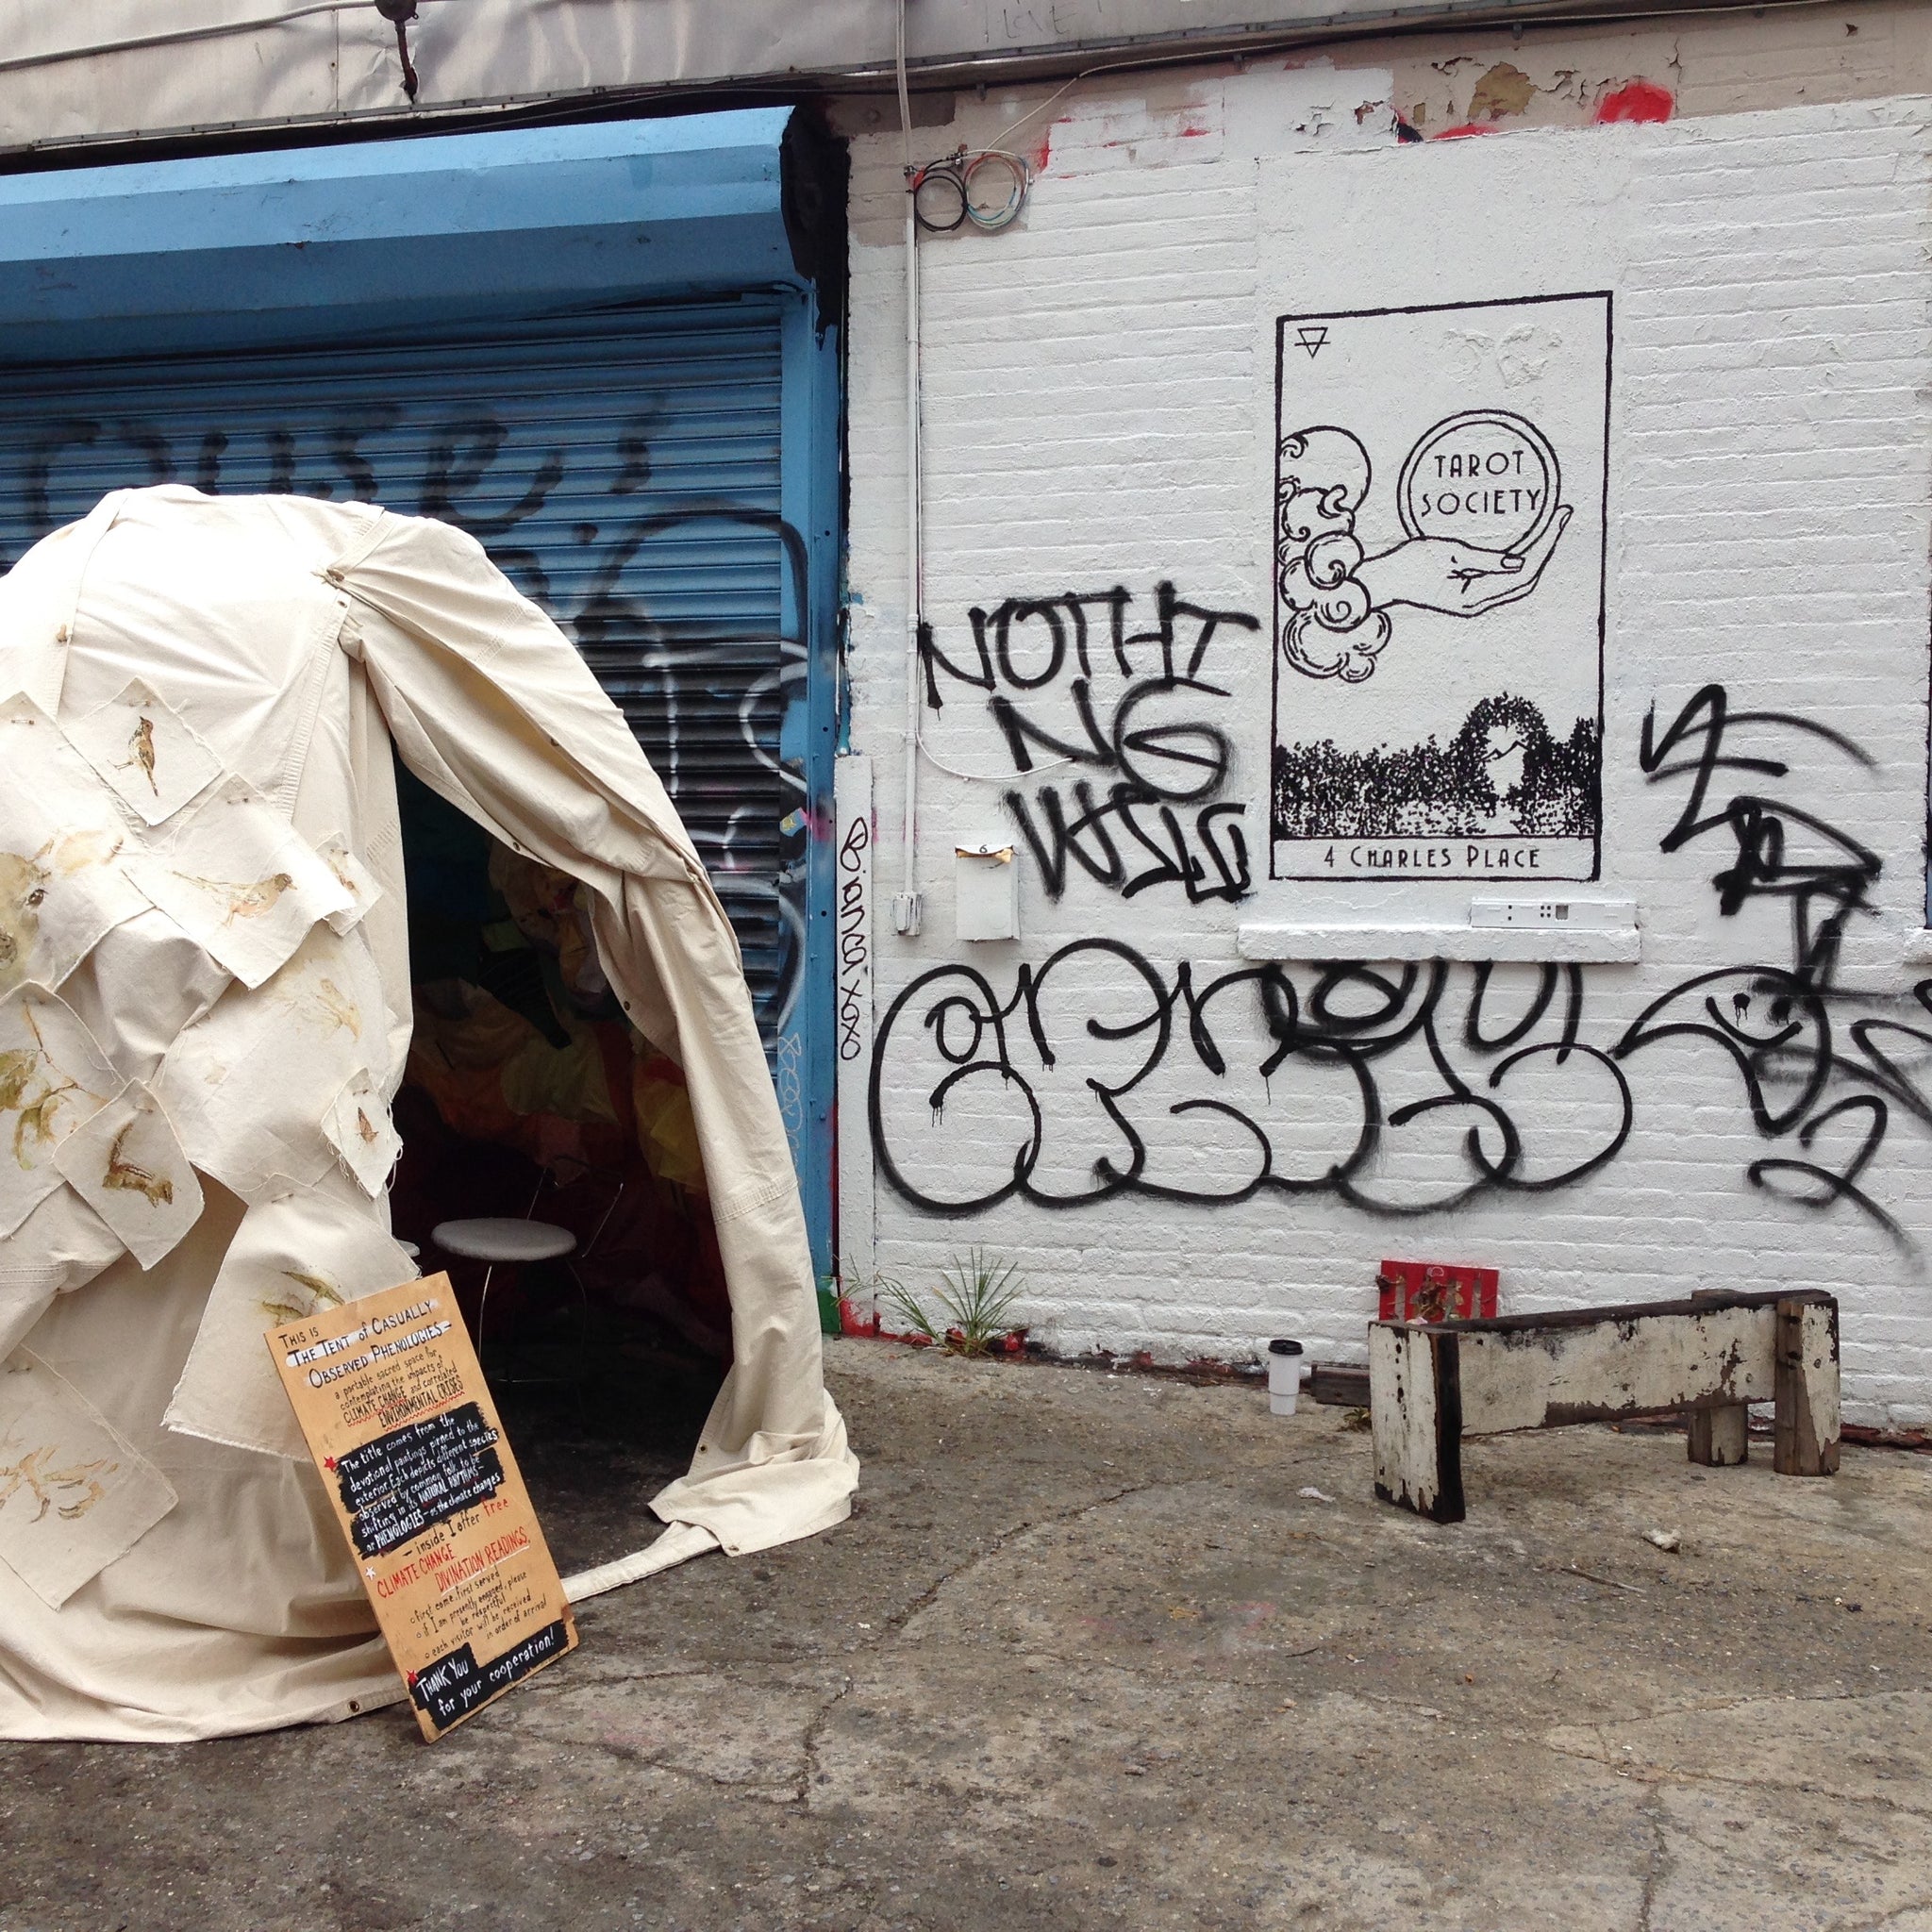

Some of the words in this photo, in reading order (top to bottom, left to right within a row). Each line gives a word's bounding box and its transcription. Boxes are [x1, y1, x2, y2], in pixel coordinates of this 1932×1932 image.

[1434, 450, 1524, 478] TAROT
[1421, 489, 1541, 517] SOCIETY
[978, 843, 988, 854] 6
[1324, 845, 1335, 868] 4
[1350, 845, 1452, 868] CHARLES
[1467, 844, 1541, 868] PLACE
[278, 1331, 307, 1349] THIS
[308, 1326, 319, 1339] IS
[287, 1348, 317, 1367] THE
[315, 1335, 350, 1357] TENT
[358, 1322, 369, 1341] of
[372, 1300, 433, 1335] CASUALLY
[308, 1356, 369, 1389] OBSERVED
[335, 1391, 340, 1400] a
[342, 1374, 374, 1400] portable
[376, 1358, 401, 1380] sacred
[404, 1352, 425, 1374] space
[425, 1346, 437, 1359] for
[340, 1381, 391, 1410] contemplating
[391, 1375, 405, 1388] the
[408, 1361, 435, 1385] impacts
[436, 1355, 445, 1369] of
[342, 1398, 378, 1424] CLIMATE
[377, 1386, 408, 1408] CHANGE
[410, 1381, 422, 1394] and
[423, 1360, 458, 1388] correlated
[377, 1389, 439, 1428] ENVIRONMENTAL
[436, 1374, 464, 1400] CRISES
[341, 1458, 360, 1474] The
[359, 1443, 383, 1465] title
[386, 1432, 413, 1451] comes
[414, 1423, 436, 1439] from
[440, 1412, 455, 1427] the
[350, 1456, 393, 1492] devotional
[394, 1445, 427, 1474] paintings
[429, 1427, 455, 1455] pinned
[457, 1426, 466, 1437] to
[466, 1419, 480, 1433] the
[409, 1458, 437, 1480] depicts
[437, 1439, 468, 1463] different
[469, 1429, 498, 1452] species
[358, 1493, 397, 1522] observed
[398, 1488, 412, 1505] by
[410, 1473, 441, 1493] common
[442, 1460, 458, 1476] folk
[459, 1457, 470, 1469] to
[469, 1454, 480, 1465] be
[361, 1512, 398, 1538] shifting
[396, 1504, 406, 1515] in
[408, 1497, 418, 1510] its
[418, 1478, 449, 1504] NATURAL
[437, 1498, 449, 1512] the
[448, 1489, 473, 1507] climate
[473, 1472, 501, 1494] changes
[415, 1527, 445, 1556] inside
[447, 1519, 457, 1538] I
[458, 1509, 481, 1533] offer
[481, 1495, 509, 1517] free
[377, 1562, 420, 1599] CLIMATE
[419, 1542, 457, 1575] CHANGE
[414, 1604, 432, 1623] first
[474, 1565, 500, 1590] served
[435, 1550, 487, 1593] DIVINATION
[449, 1597, 478, 1624] presently
[508, 1571, 527, 1591] please
[431, 1640, 449, 1657] each
[451, 1626, 474, 1646] visitor
[476, 1616, 491, 1630] will
[490, 1610, 499, 1623] be
[503, 1588, 531, 1614] received
[459, 1616, 469, 1626] be
[472, 1592, 507, 1619] respectful
[494, 1617, 512, 1635] order
[523, 1592, 547, 1617] arrival
[415, 1666, 452, 1702] THANK
[438, 1697, 457, 1717] for
[459, 1679, 482, 1708] your
[489, 1626, 555, 1682] cooperation!
